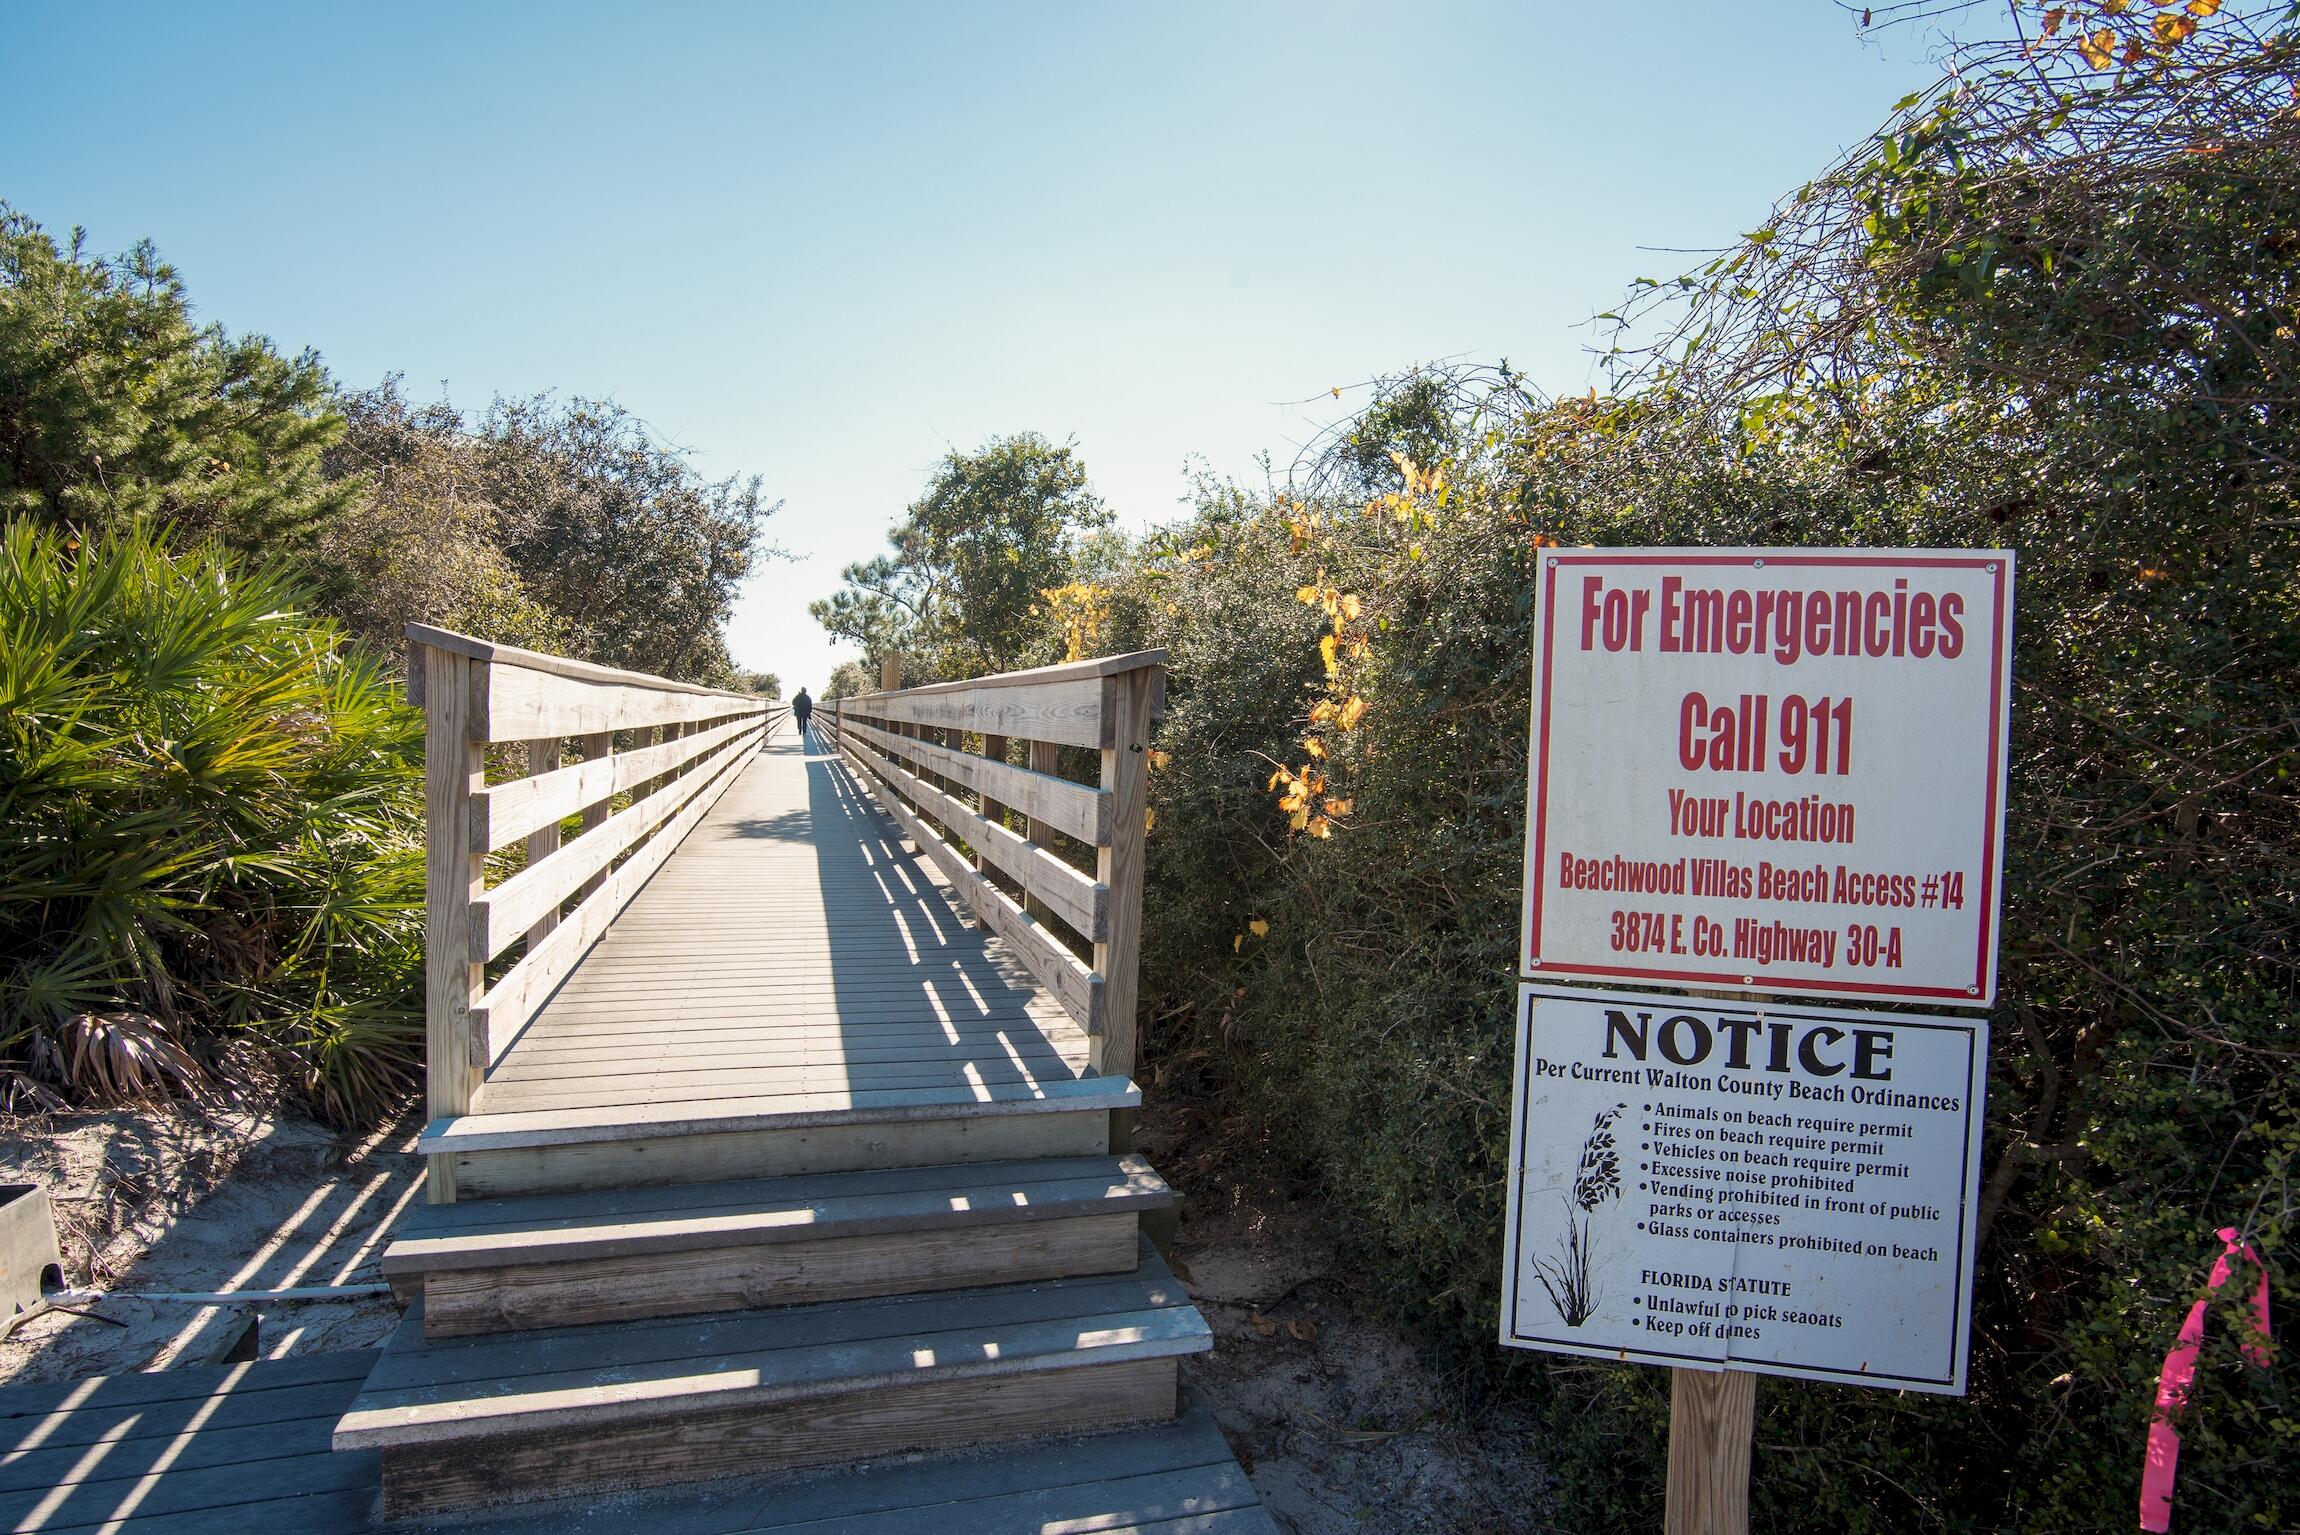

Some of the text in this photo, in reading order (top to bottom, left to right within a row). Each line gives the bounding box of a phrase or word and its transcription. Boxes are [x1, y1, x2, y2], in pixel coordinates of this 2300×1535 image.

[1581, 577, 1963, 665] For Emergencies
[1680, 692, 1852, 775] Call 911
[1669, 789, 1854, 843] Your Location
[1560, 852, 1963, 909] Beachwood Villas Beach Access #14
[1611, 911, 1901, 968] 3874 E. Co. Highway 30-A
[1601, 1010, 1895, 1082] NOTICE
[1536, 1059, 1959, 1111] Per Current Walton County Beach Ordinances
[1654, 1122, 1883, 1155] Fires on beach require permit
[1655, 1103, 1912, 1137] Animals on beach require permit
[1652, 1161, 1854, 1193] Excessive noise prohibited
[1654, 1142, 1909, 1177] Vehicles on beach require permit
[1650, 1204, 1779, 1225] parks or accesses
[1651, 1181, 1939, 1220] Vending prohibited in front of public
[1649, 1221, 1937, 1261] Glass containers prohibited on beach
[1642, 1270, 1790, 1296] FLORIDA STATUTE
[1646, 1316, 1683, 1337] Keep
[1689, 1322, 1711, 1337] off
[1648, 1295, 1720, 1317] Unlawful
[1743, 1305, 1776, 1320] pick
[1782, 1311, 1841, 1327] seaoats
